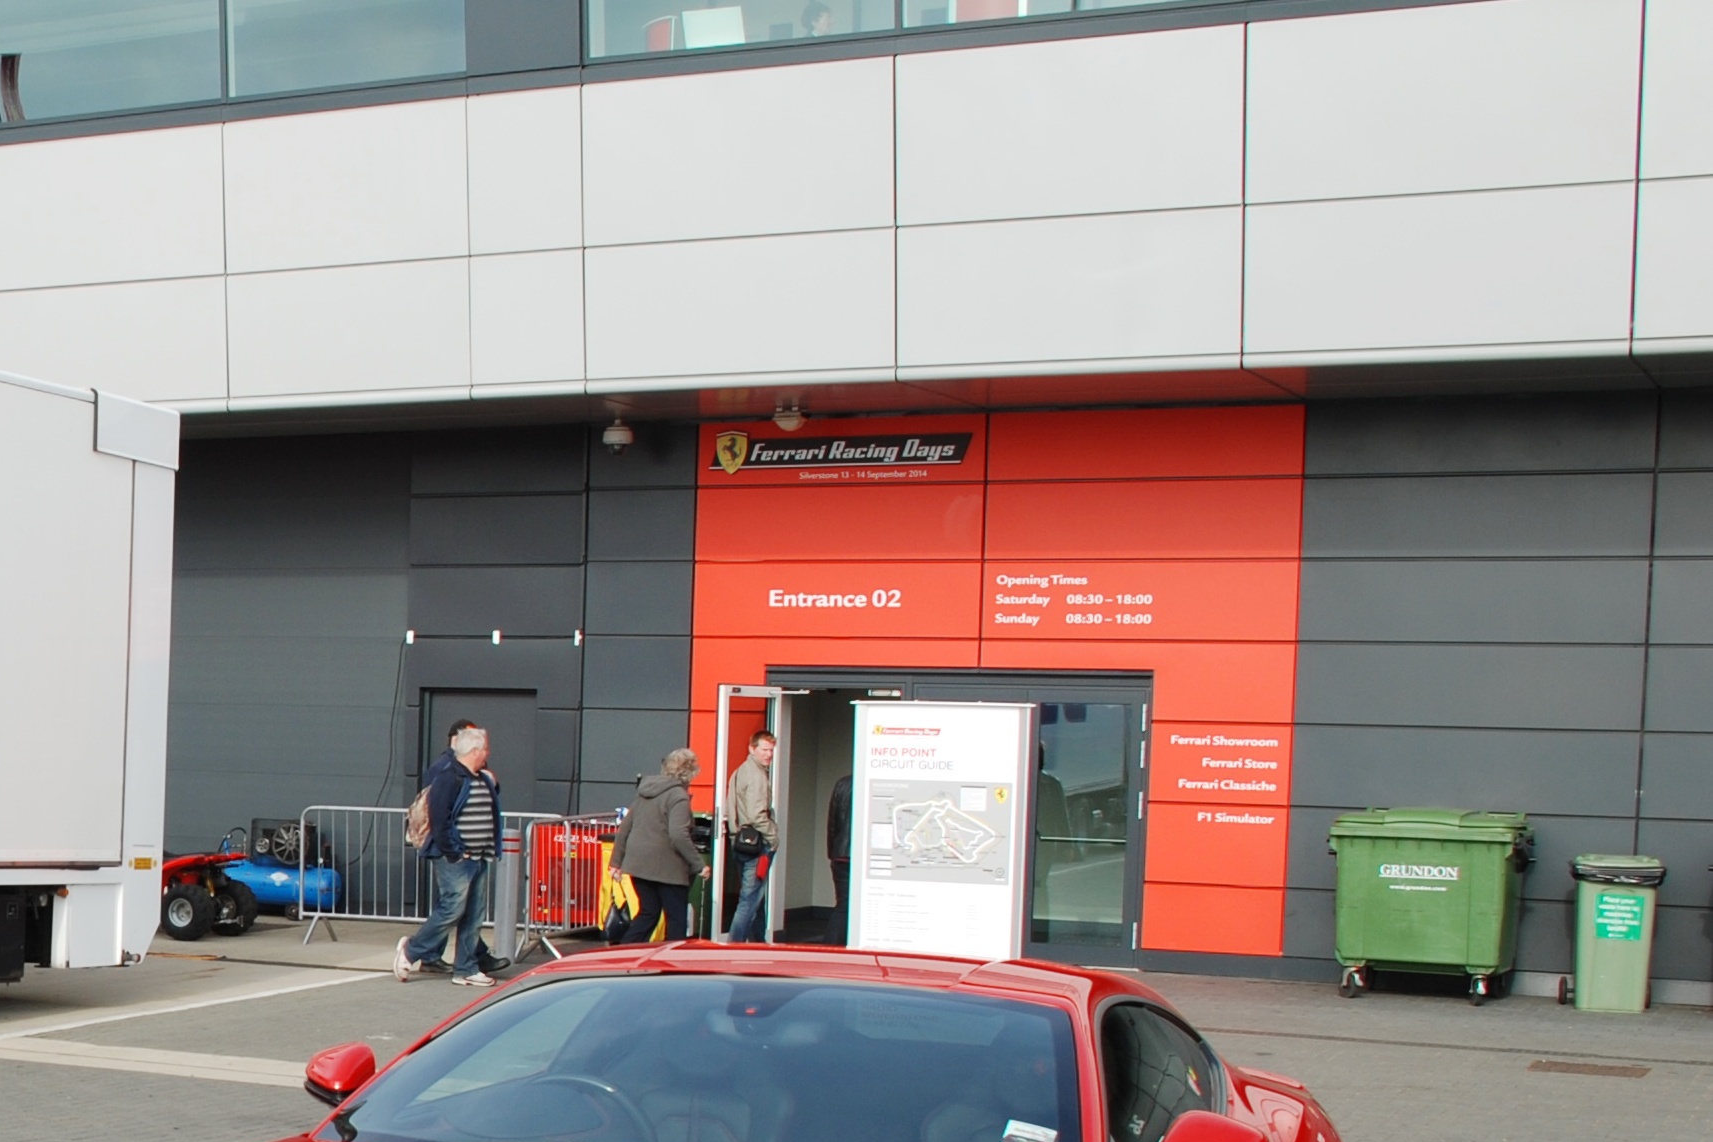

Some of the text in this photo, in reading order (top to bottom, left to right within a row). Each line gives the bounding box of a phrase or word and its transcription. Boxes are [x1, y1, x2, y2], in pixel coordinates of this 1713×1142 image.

[750, 438, 956, 462] Ferrari Racing Days
[799, 471, 839, 480] Silverstone
[841, 471, 850, 479] 13
[856, 470, 866, 479] 14
[867, 470, 907, 480] September
[908, 470, 928, 478] 2014
[996, 574, 1088, 589] Opening Times
[768, 589, 902, 608] Entrance 02
[995, 594, 1050, 608] Saturday
[1065, 594, 1104, 605] 08:30
[1116, 594, 1153, 605] 18:00
[994, 613, 1040, 627] Sunday
[1065, 613, 1104, 625] 08:30
[1115, 613, 1152, 625] 18:00
[1170, 734, 1279, 747] Ferrari Showroom
[871, 747, 937, 758] INFO POINT
[870, 759, 954, 771] CIRCUIT GUIDE
[1201, 757, 1277, 769] Ferrari Store
[1178, 778, 1277, 791] Ferrari Classiche
[1197, 812, 1275, 824] F1 Simulator
[1379, 863, 1459, 879] GRUNDON
